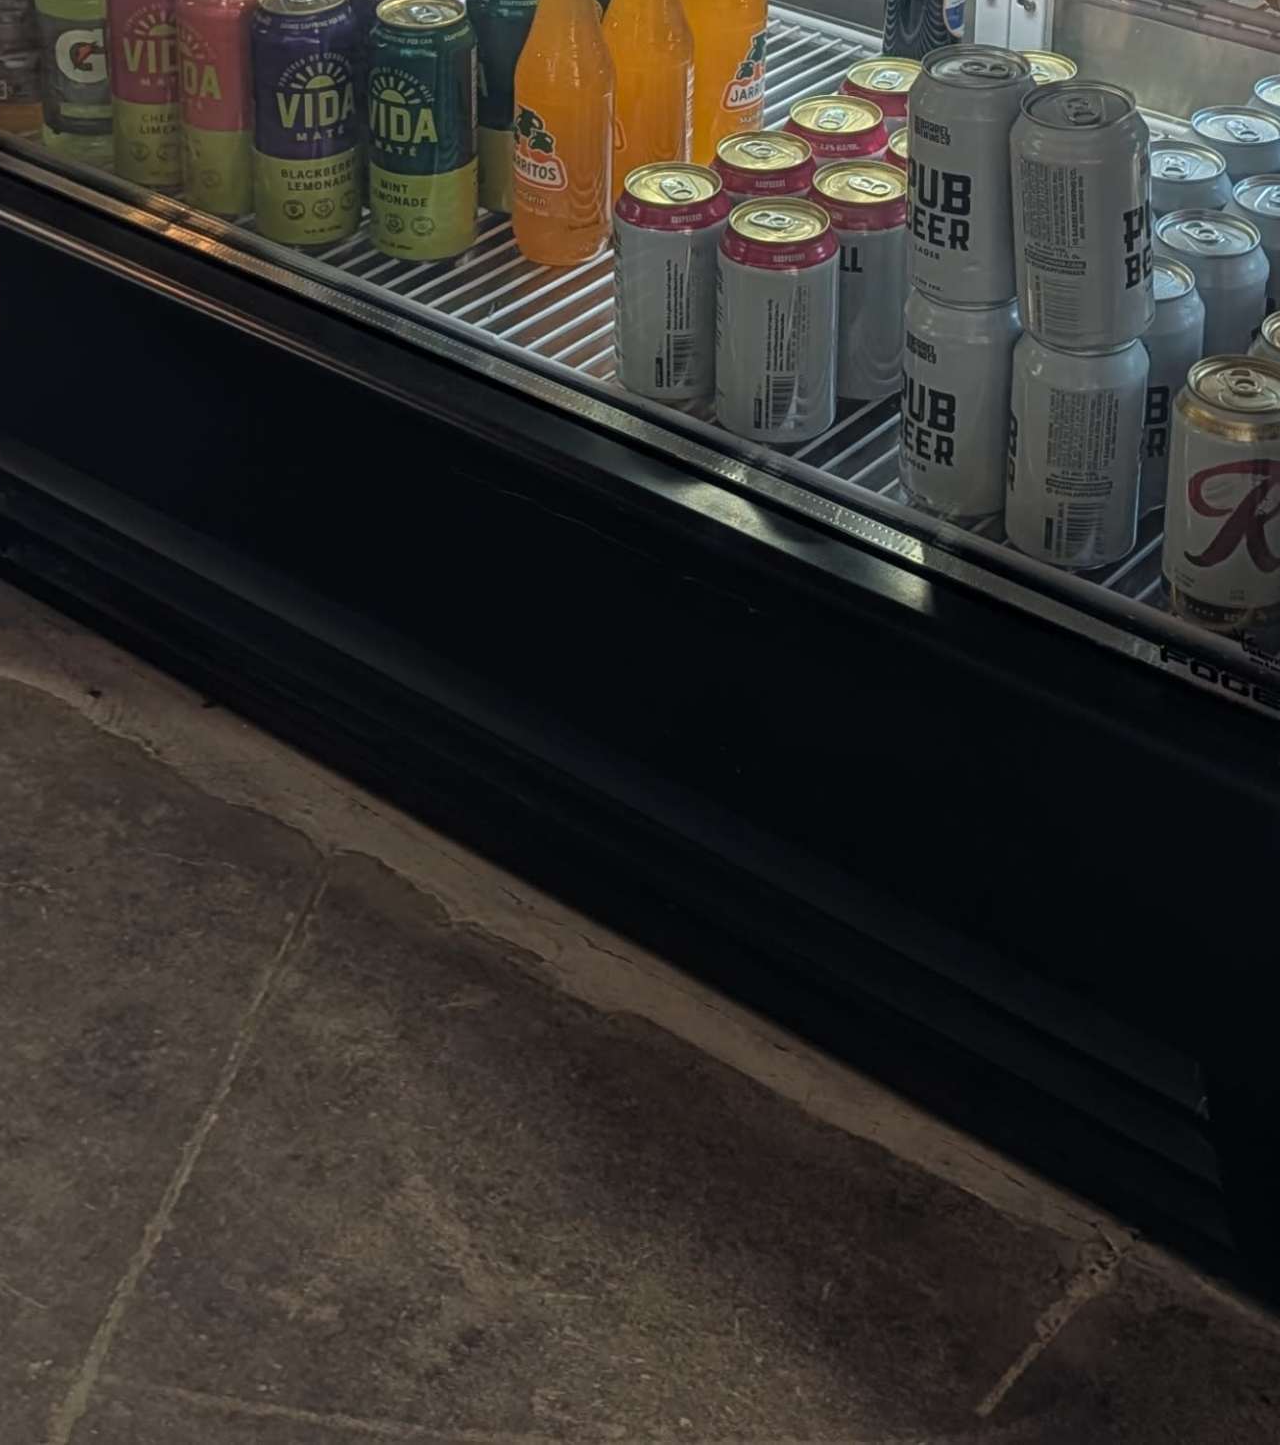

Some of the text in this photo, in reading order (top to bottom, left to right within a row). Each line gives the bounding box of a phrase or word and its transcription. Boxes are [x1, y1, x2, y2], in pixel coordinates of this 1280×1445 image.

[276, 81, 356, 129] VIDA
[287, 172, 353, 192] LEMONADE
[379, 178, 409, 195] MINT
